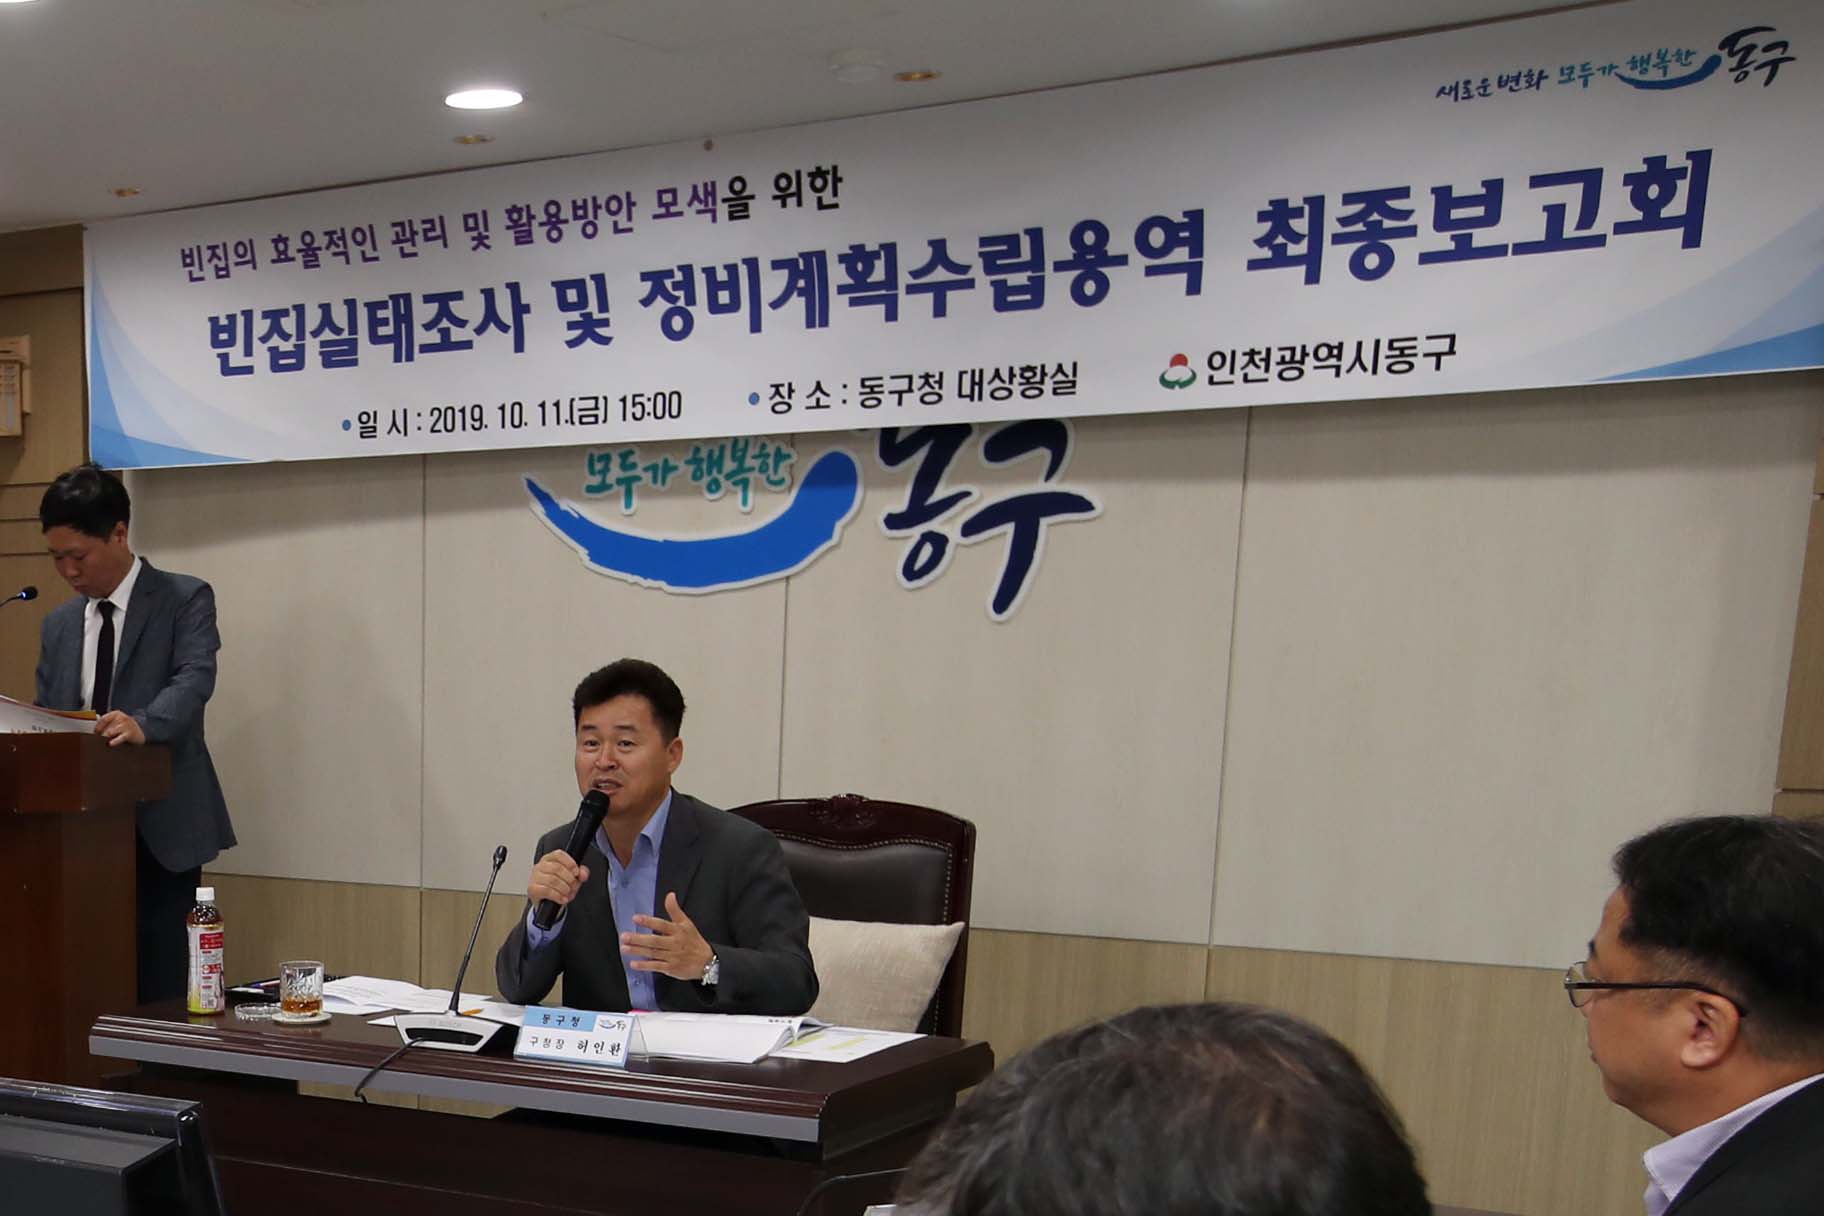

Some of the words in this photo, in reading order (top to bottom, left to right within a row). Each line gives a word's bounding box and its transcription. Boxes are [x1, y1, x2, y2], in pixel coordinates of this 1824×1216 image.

[1497, 68, 1549, 93] 변화
[1558, 60, 1617, 88] 모두가
[1626, 47, 1697, 78] 행복한
[180, 237, 258, 283] 빈집의
[270, 223, 379, 270] 효율적인
[390, 214, 449, 259] 관리
[462, 209, 492, 252] 및
[504, 190, 638, 247] 활용방안
[651, 174, 757, 223] 모색을
[771, 163, 844, 209] 위한
[207, 281, 532, 377] 빈집실태조사
[551, 272, 614, 349] 및
[638, 207, 1205, 342] 정비계획수립용역
[1245, 147, 1714, 285] 최종보고회
[1206, 332, 1457, 387] 인천광역시동구
[858, 370, 945, 410] 동구청
[956, 360, 1079, 403] 대상황실
[429, 403, 489, 434] 2019.
[496, 400, 529, 430] 10.
[618, 389, 683, 423] 15:00
[584, 448, 679, 511] 모두가
[683, 437, 793, 508] 행복한
[529, 1035, 565, 1050] 구청장
[542, 1013, 581, 1028] 동구청
